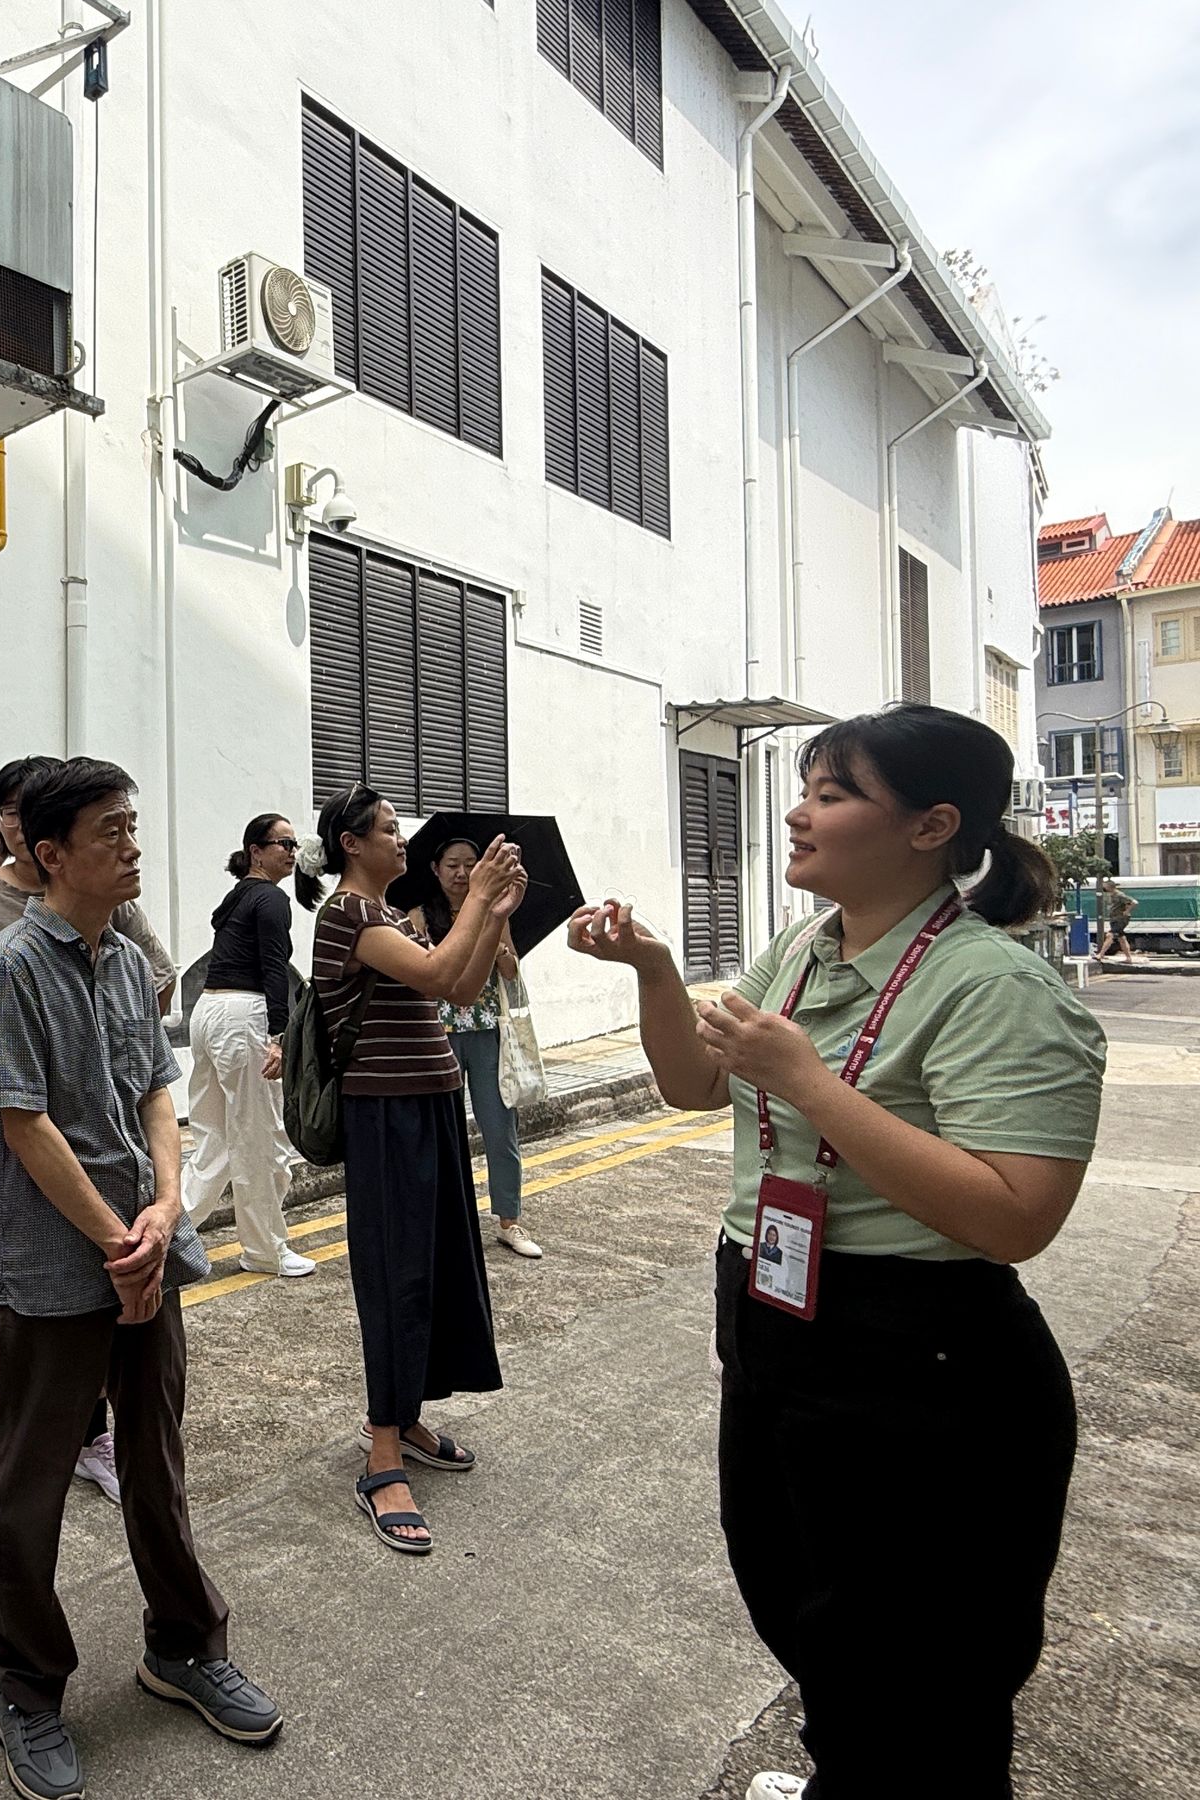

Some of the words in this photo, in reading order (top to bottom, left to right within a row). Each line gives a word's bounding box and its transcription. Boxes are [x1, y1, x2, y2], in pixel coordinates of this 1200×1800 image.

[868, 991, 893, 1030] SINGAPORE
[889, 963, 910, 991] TOURIST
[906, 943, 925, 965] GUIDE
[850, 1049, 864, 1072] GUIDE
